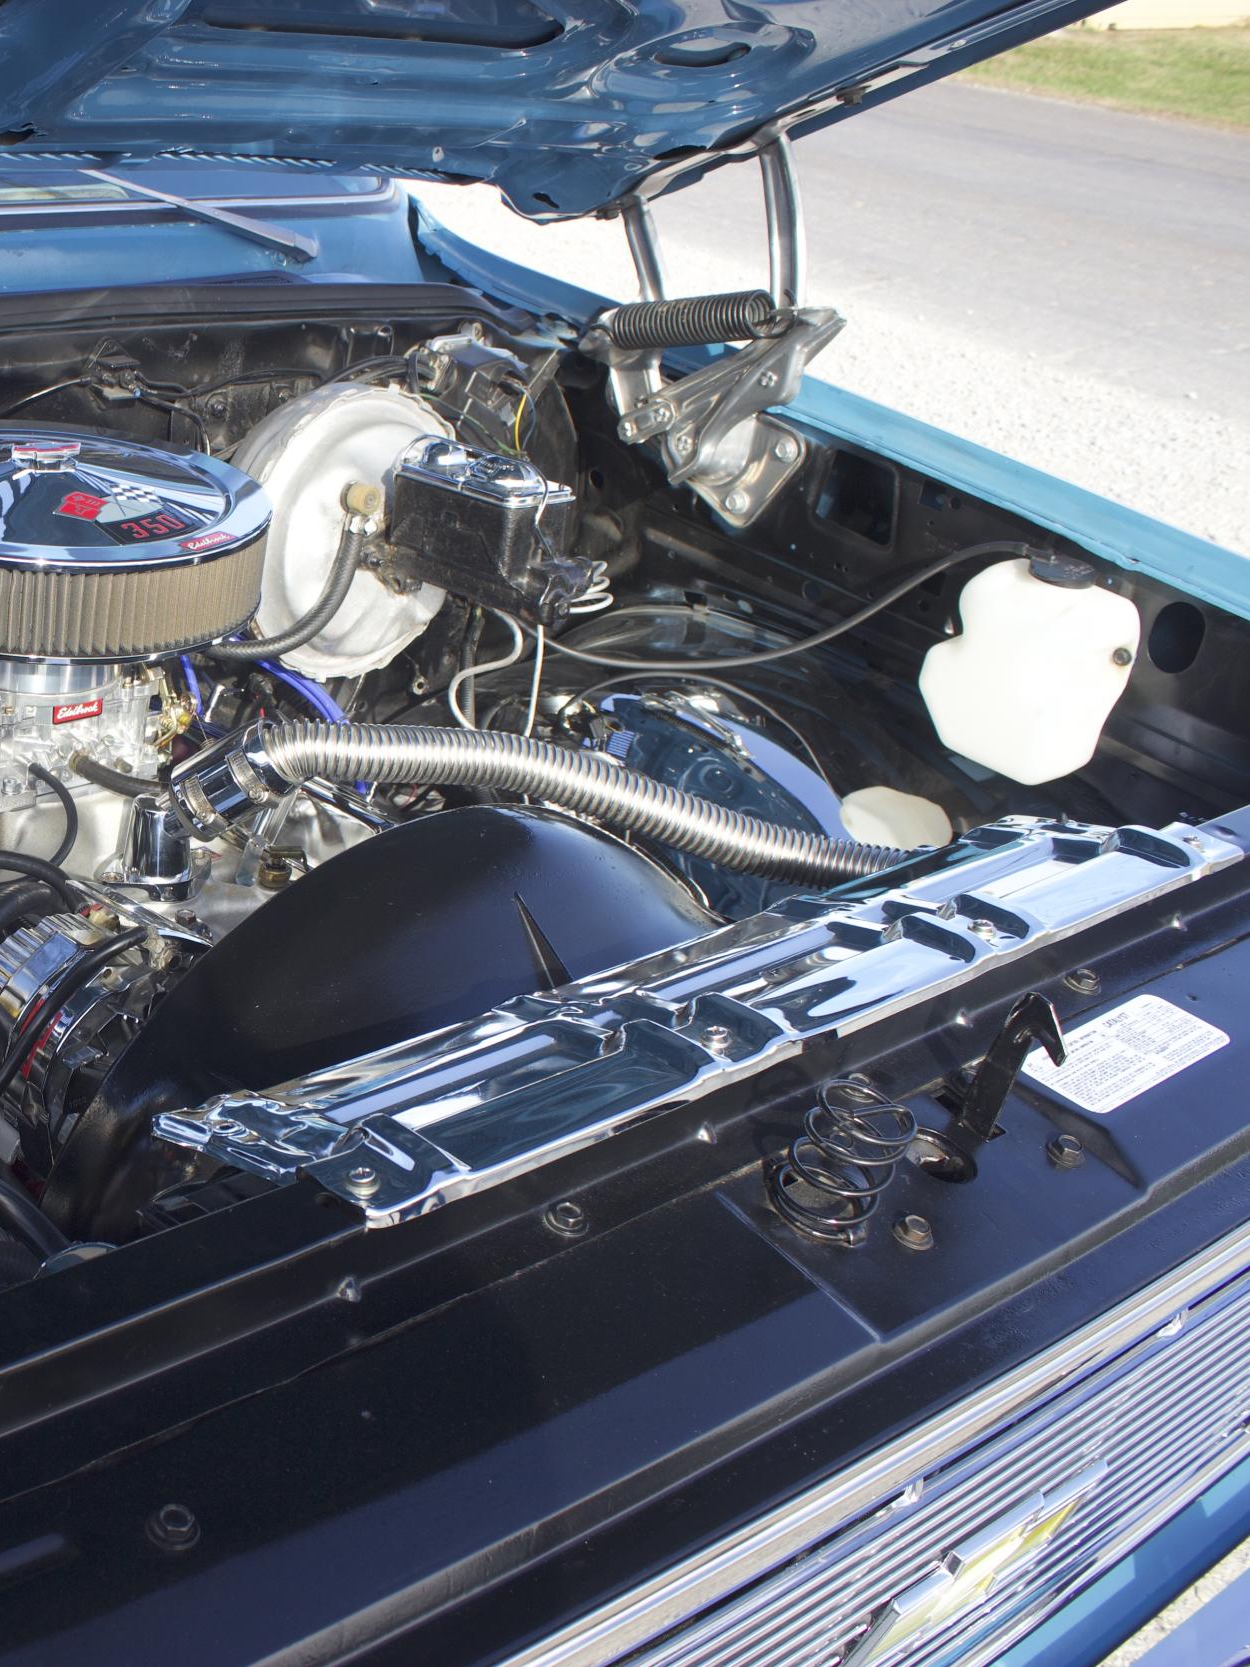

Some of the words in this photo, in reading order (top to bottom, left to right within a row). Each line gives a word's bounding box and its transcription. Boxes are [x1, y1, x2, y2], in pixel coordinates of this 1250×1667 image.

[121, 514, 185, 539] 350
[187, 533, 231, 551] Edelbrock
[57, 701, 98, 720] Edelbrock
